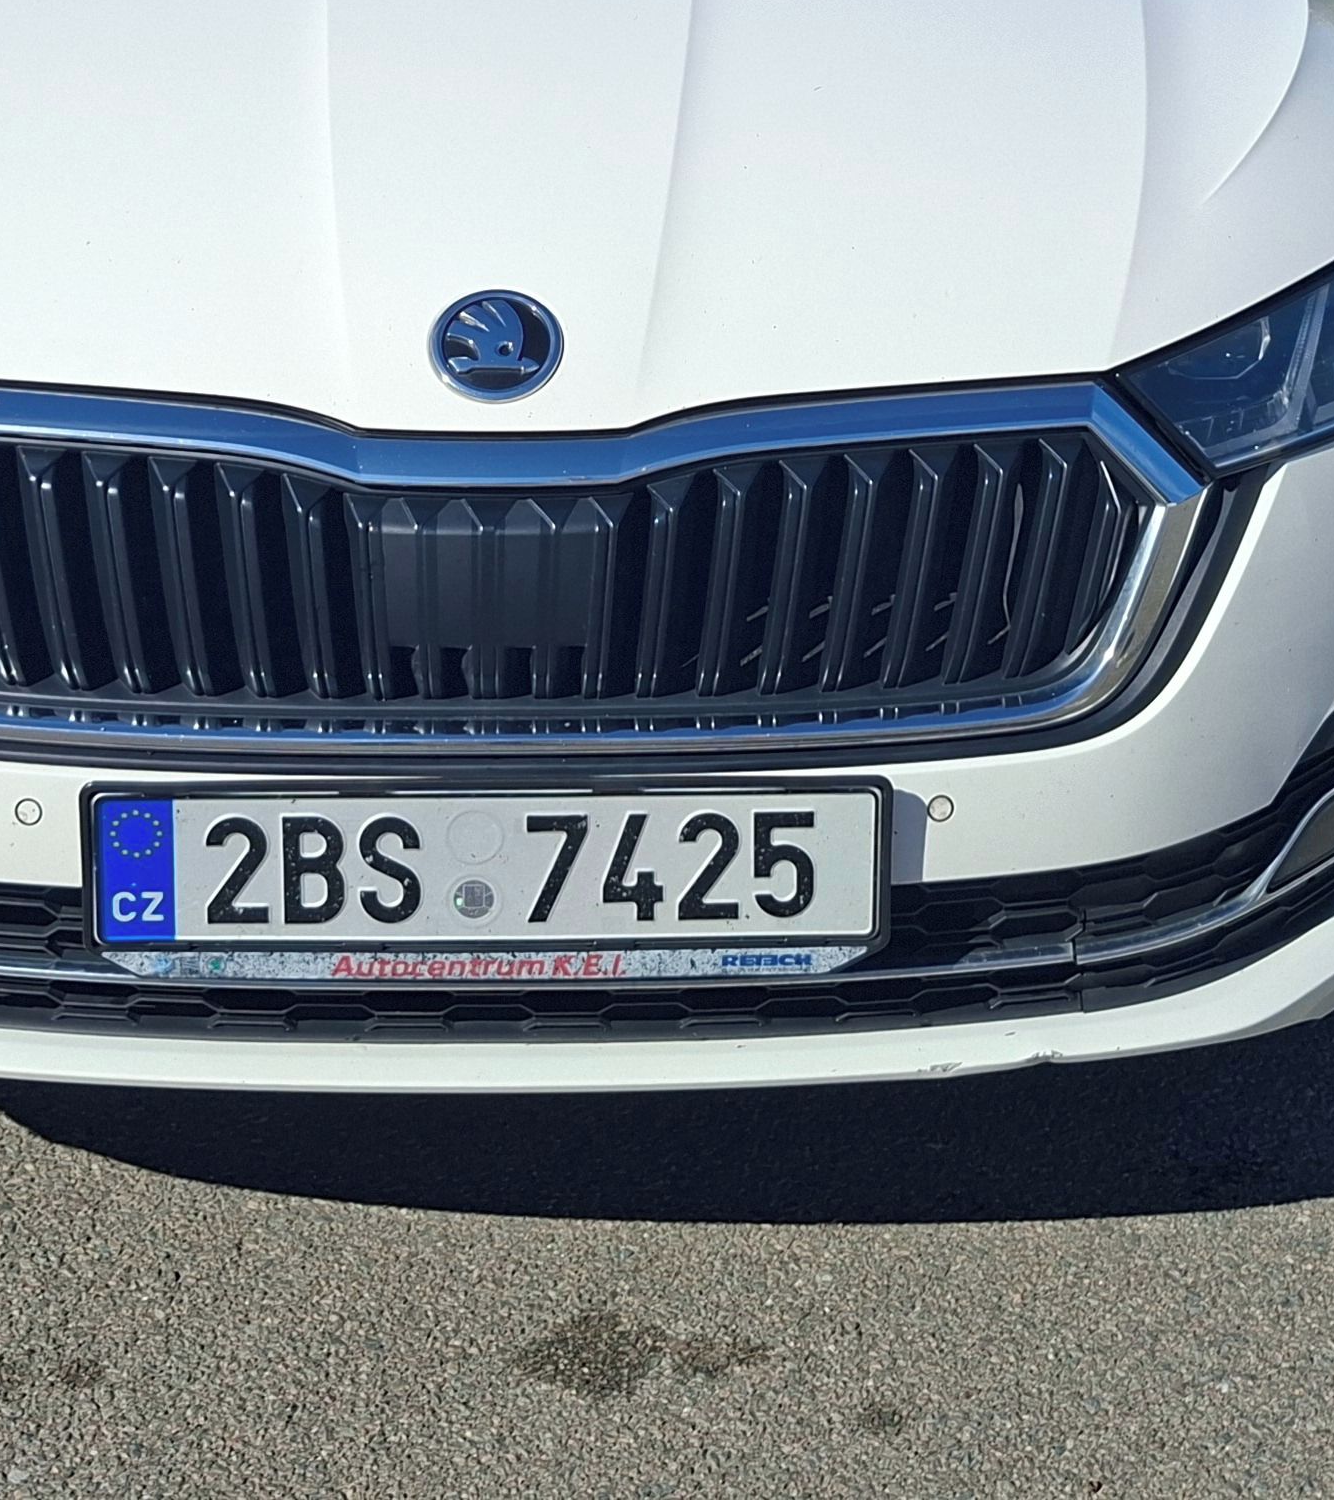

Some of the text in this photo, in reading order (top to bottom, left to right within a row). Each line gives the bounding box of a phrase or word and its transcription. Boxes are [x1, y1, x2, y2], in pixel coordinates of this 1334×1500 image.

[205, 811, 815, 924] 2BS 7425
[112, 891, 165, 922] CZ
[331, 955, 545, 978] Autocentrum
